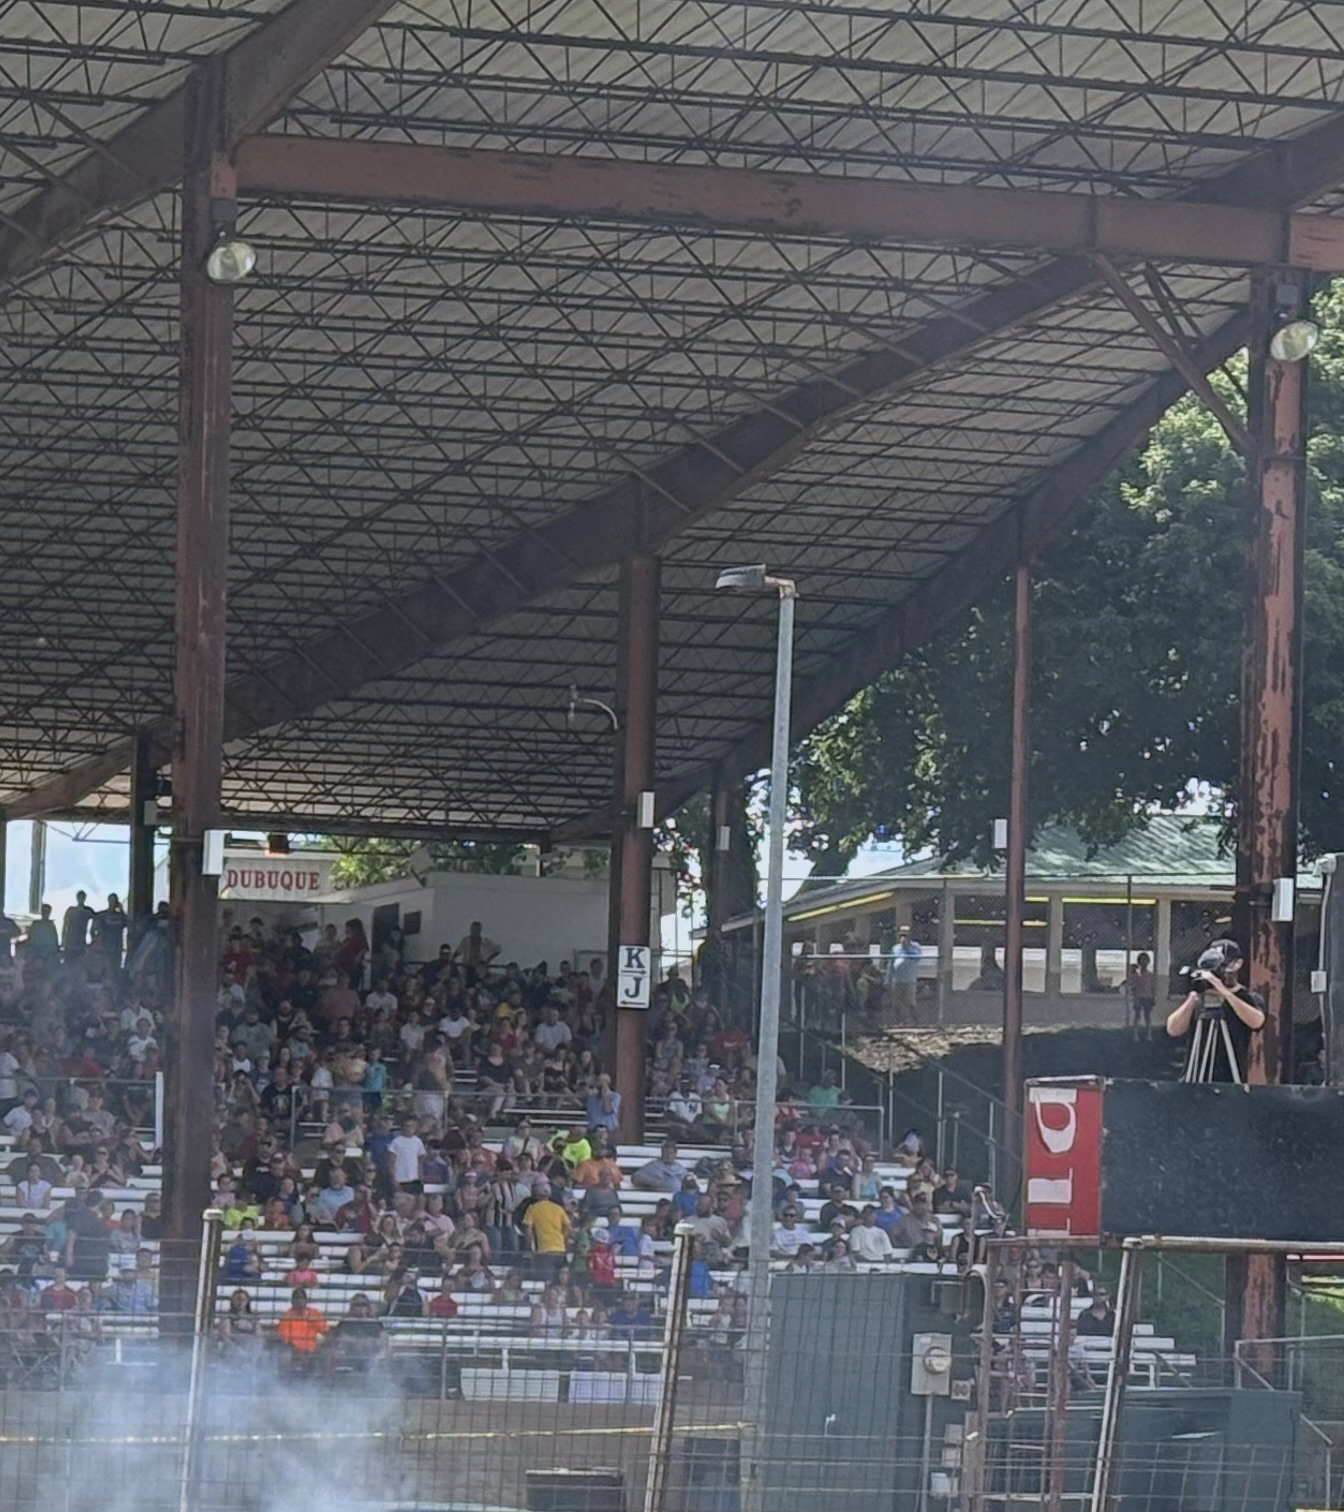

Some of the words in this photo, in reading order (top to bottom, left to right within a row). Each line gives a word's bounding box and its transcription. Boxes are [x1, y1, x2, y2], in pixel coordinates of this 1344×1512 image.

[226, 869, 321, 891] DUBUQUE
[624, 947, 646, 969] K
[624, 977, 643, 998] J
